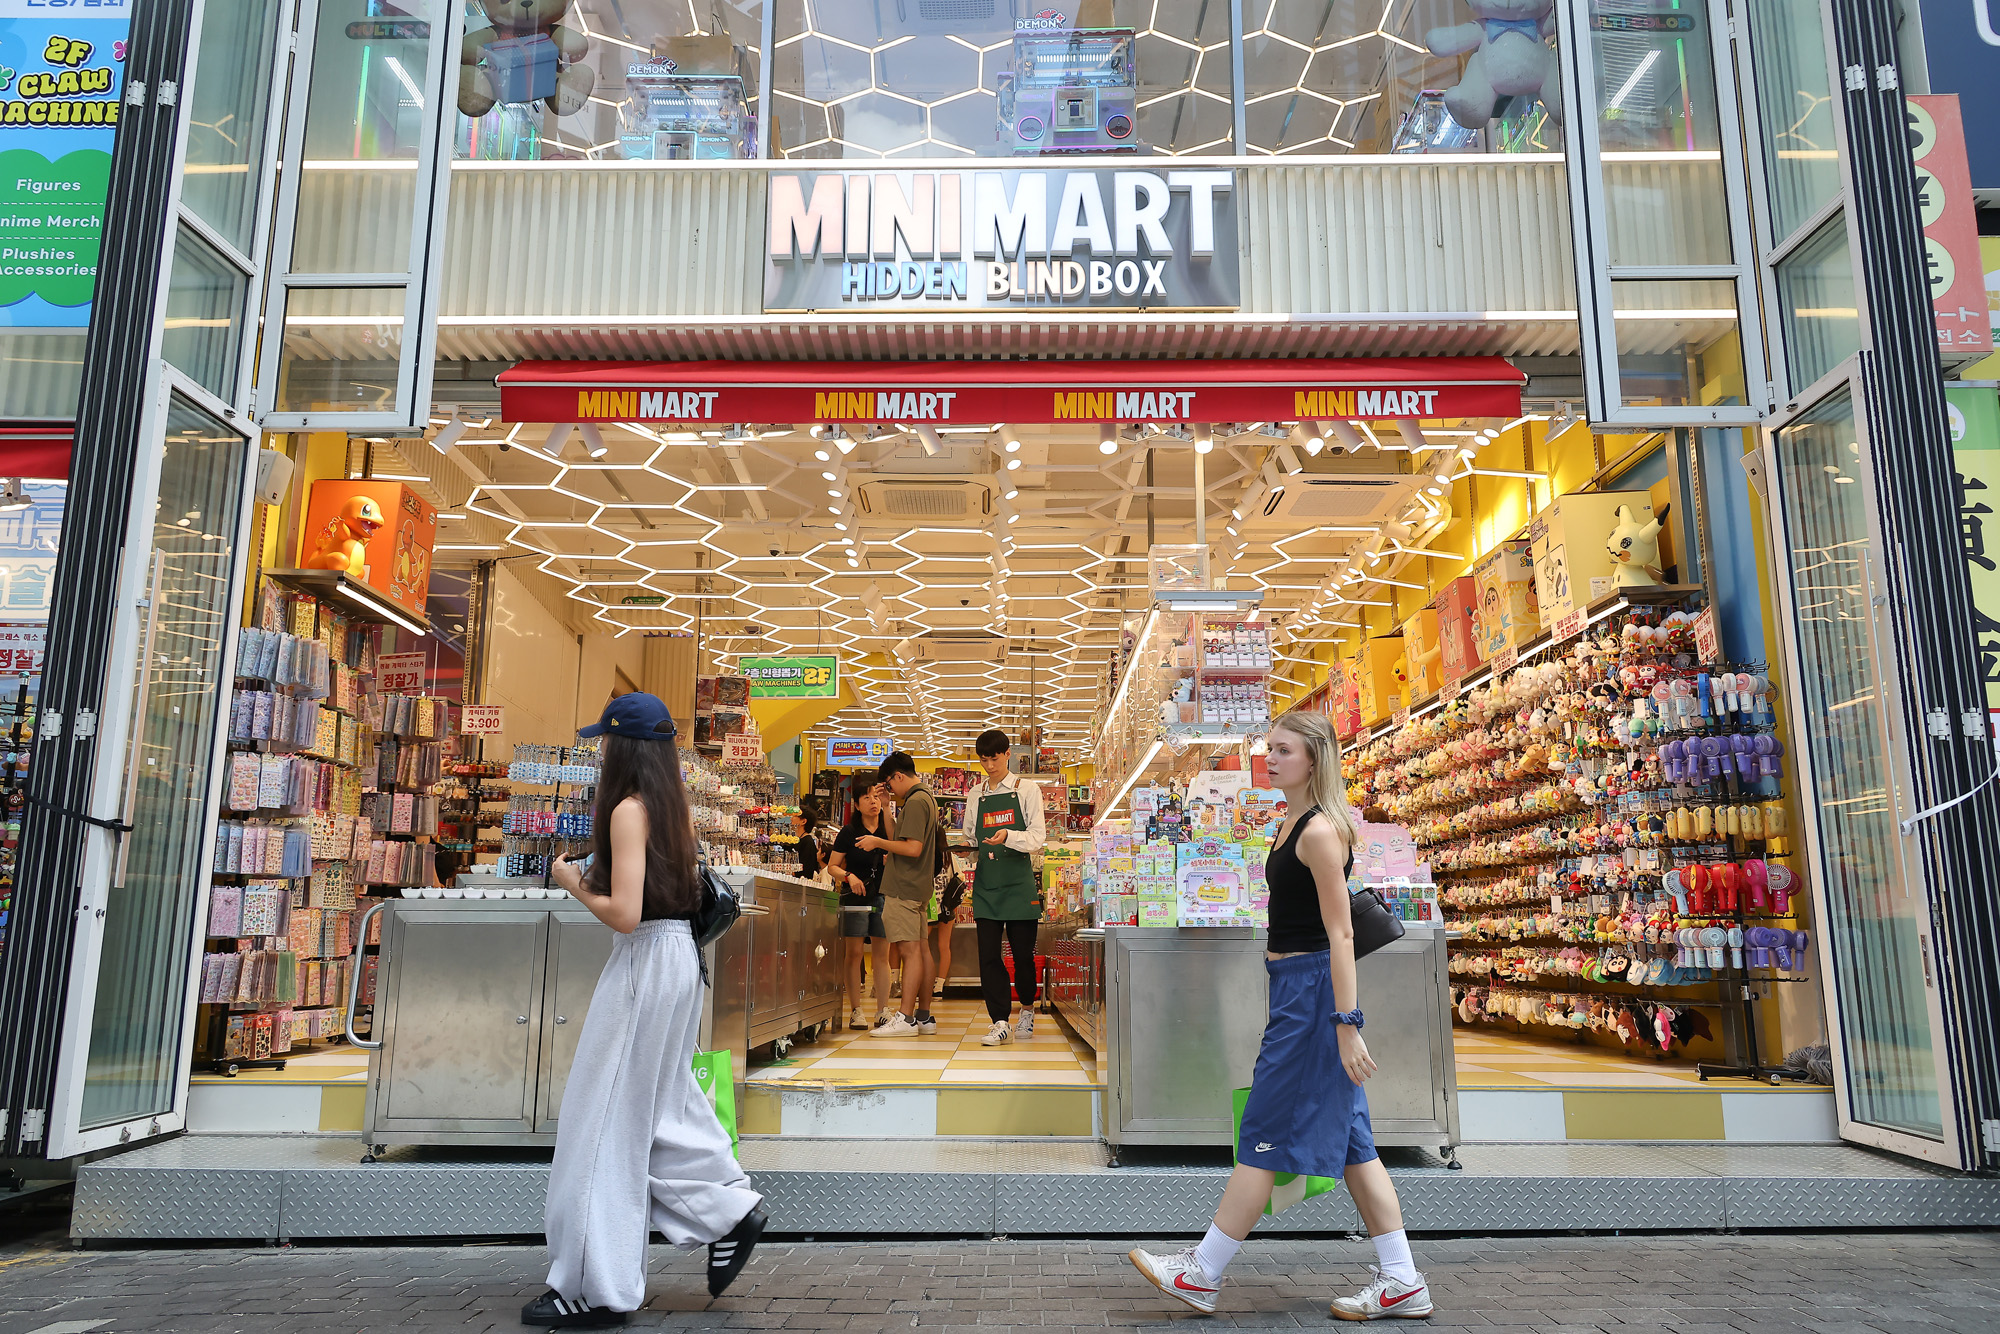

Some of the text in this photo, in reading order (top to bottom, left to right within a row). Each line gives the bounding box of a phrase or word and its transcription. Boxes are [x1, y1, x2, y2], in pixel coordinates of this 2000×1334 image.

[1016, 20, 1057, 29] DEMON
[44, 36, 93, 67] 2F
[628, 65, 668, 75] DEMON
[18, 67, 112, 99] CLAW
[0, 101, 120, 126] ACHINE
[16, 178, 81, 194] Figures
[47, 215, 100, 228] Merch
[770, 171, 1234, 259] MINI MART
[2, 247, 76, 260] Plushies
[842, 261, 967, 300] HIDDEN
[762, 667, 801, 679] 인형뽑기
[803, 667, 832, 686] 2F
[383, 672, 419, 688] 정찰가
[765, 680, 801, 688] MACHINES
[731, 745, 758, 757] 정찰가
[872, 743, 889, 756] B1
[995, 812, 1013, 824] MART
